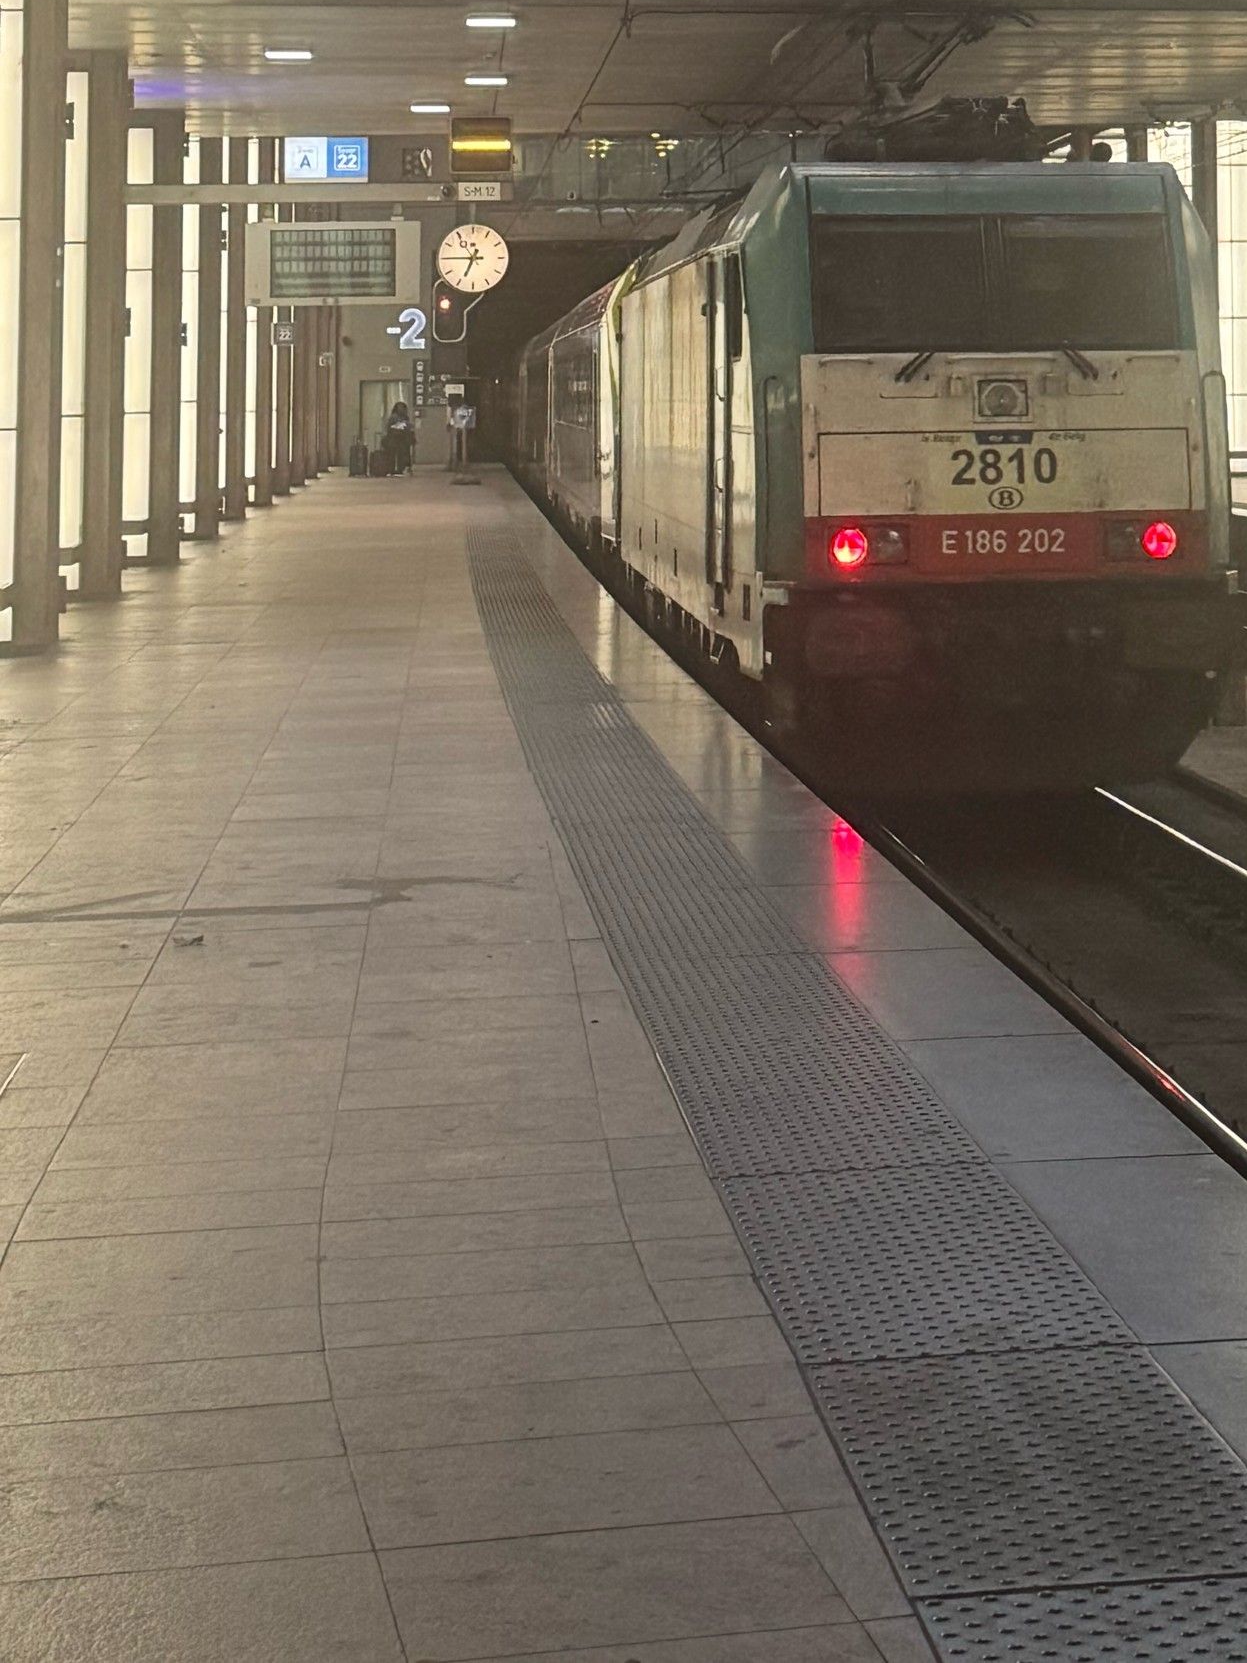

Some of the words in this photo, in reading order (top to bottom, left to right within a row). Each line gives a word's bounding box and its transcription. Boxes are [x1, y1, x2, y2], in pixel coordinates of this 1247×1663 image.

[299, 153, 312, 169] A
[337, 152, 358, 169] 22
[386, 307, 427, 350] -2
[951, 447, 1058, 485] 2810
[942, 530, 958, 554] E
[964, 529, 1008, 554] 186
[1017, 528, 1066, 553] 202
